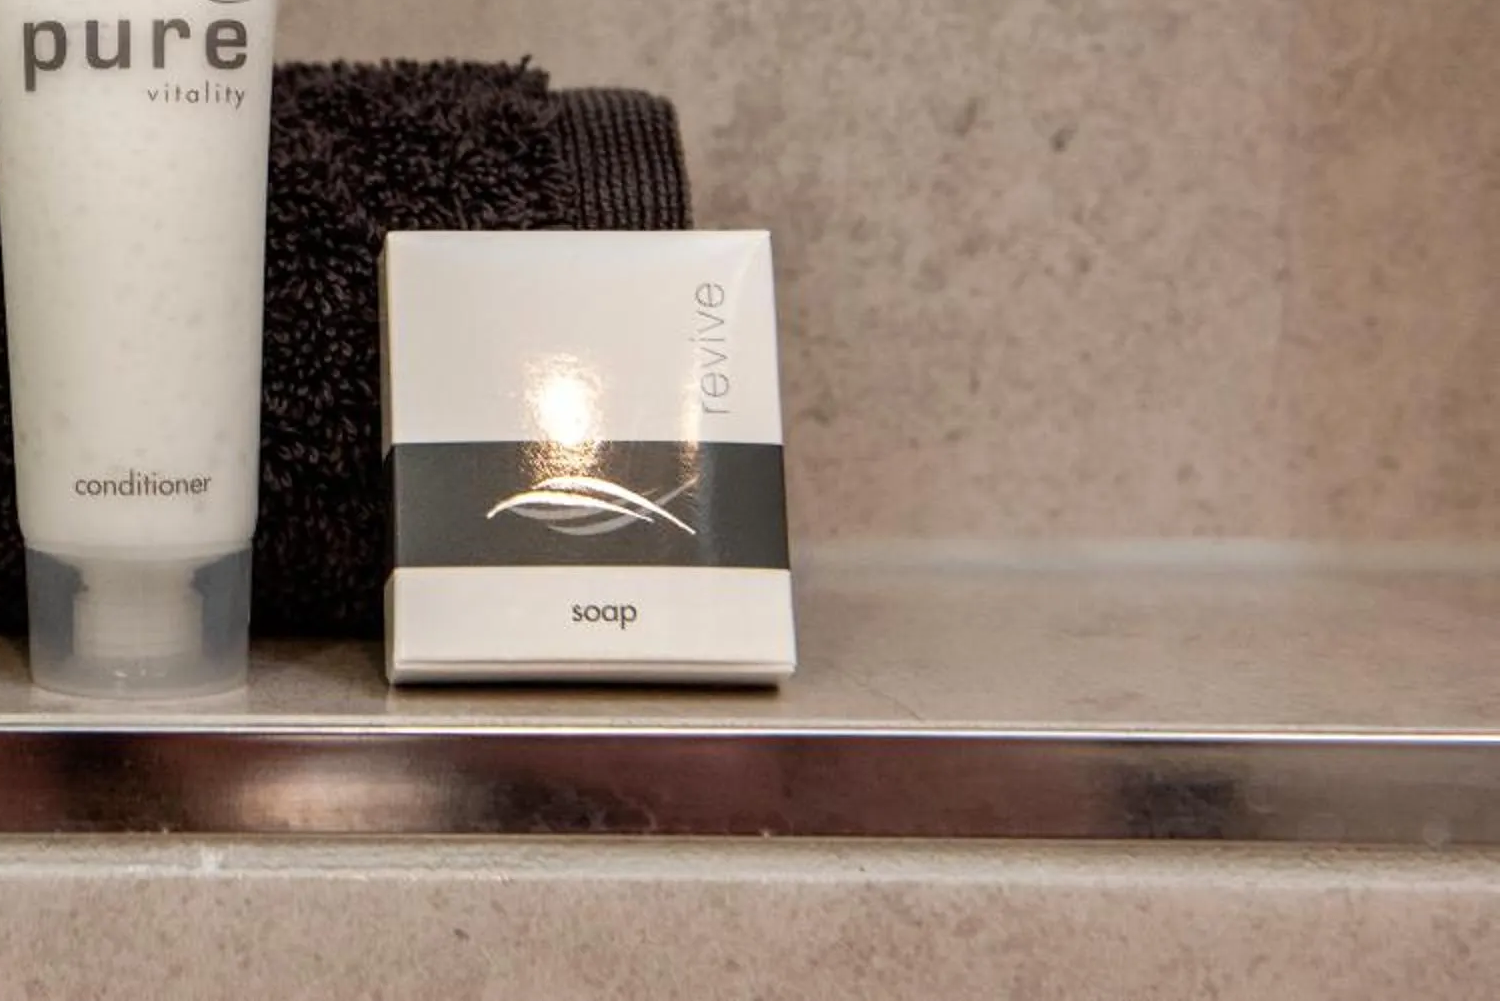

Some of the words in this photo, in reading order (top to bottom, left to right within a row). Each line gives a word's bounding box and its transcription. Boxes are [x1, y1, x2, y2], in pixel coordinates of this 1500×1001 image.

[147, 80, 246, 109] vitality
[688, 281, 731, 415] revive
[75, 468, 212, 496] conditioner
[571, 600, 638, 629] soap
